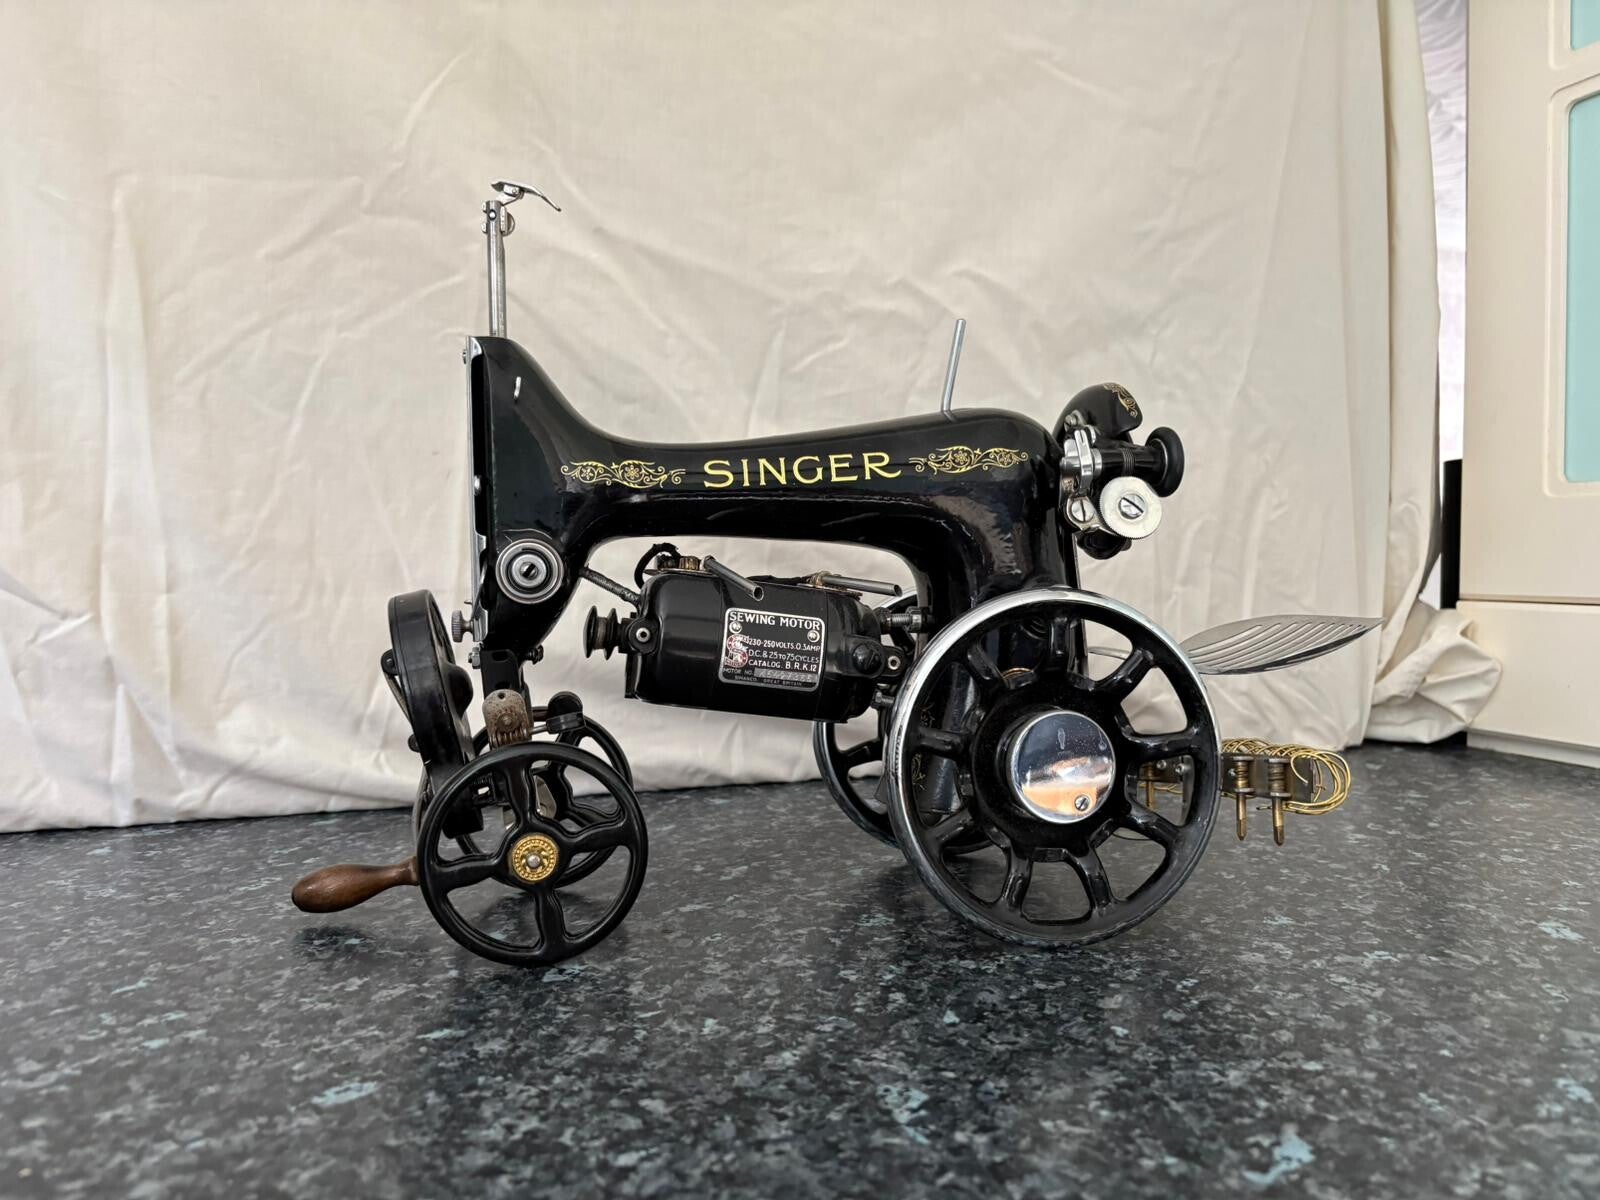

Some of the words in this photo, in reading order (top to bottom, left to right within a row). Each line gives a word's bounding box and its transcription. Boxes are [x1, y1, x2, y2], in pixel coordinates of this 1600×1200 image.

[703, 452, 902, 488] SINGER
[730, 612, 775, 625] SEWING
[780, 617, 821, 630] MOTOR
